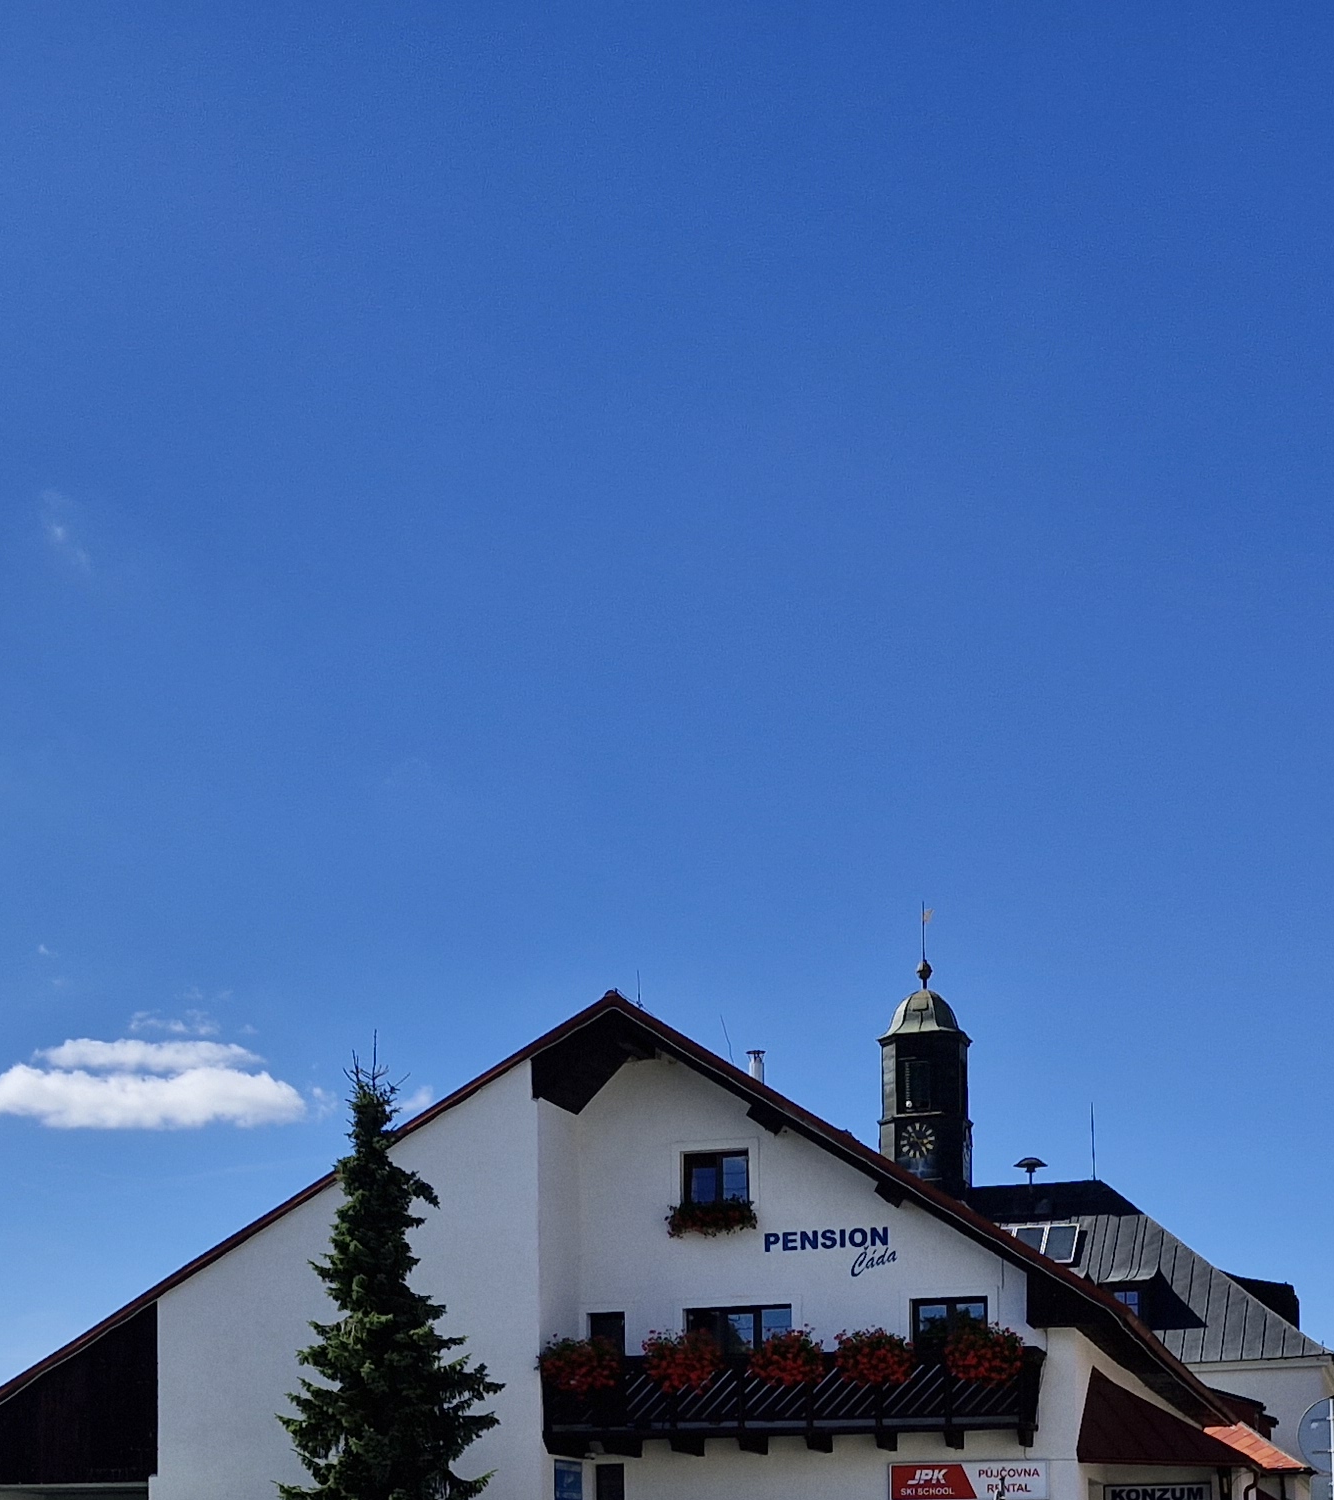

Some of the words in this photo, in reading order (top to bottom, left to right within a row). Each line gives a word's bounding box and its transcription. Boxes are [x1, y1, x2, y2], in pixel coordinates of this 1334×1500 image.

[764, 1226, 889, 1253] PENSION
[851, 1245, 898, 1278] Čáda
[907, 1469, 949, 1485] JPK
[978, 1466, 1040, 1480] PŮJČOVNA
[900, 1488, 916, 1496] SKI
[917, 1486, 955, 1496] SCHOOL
